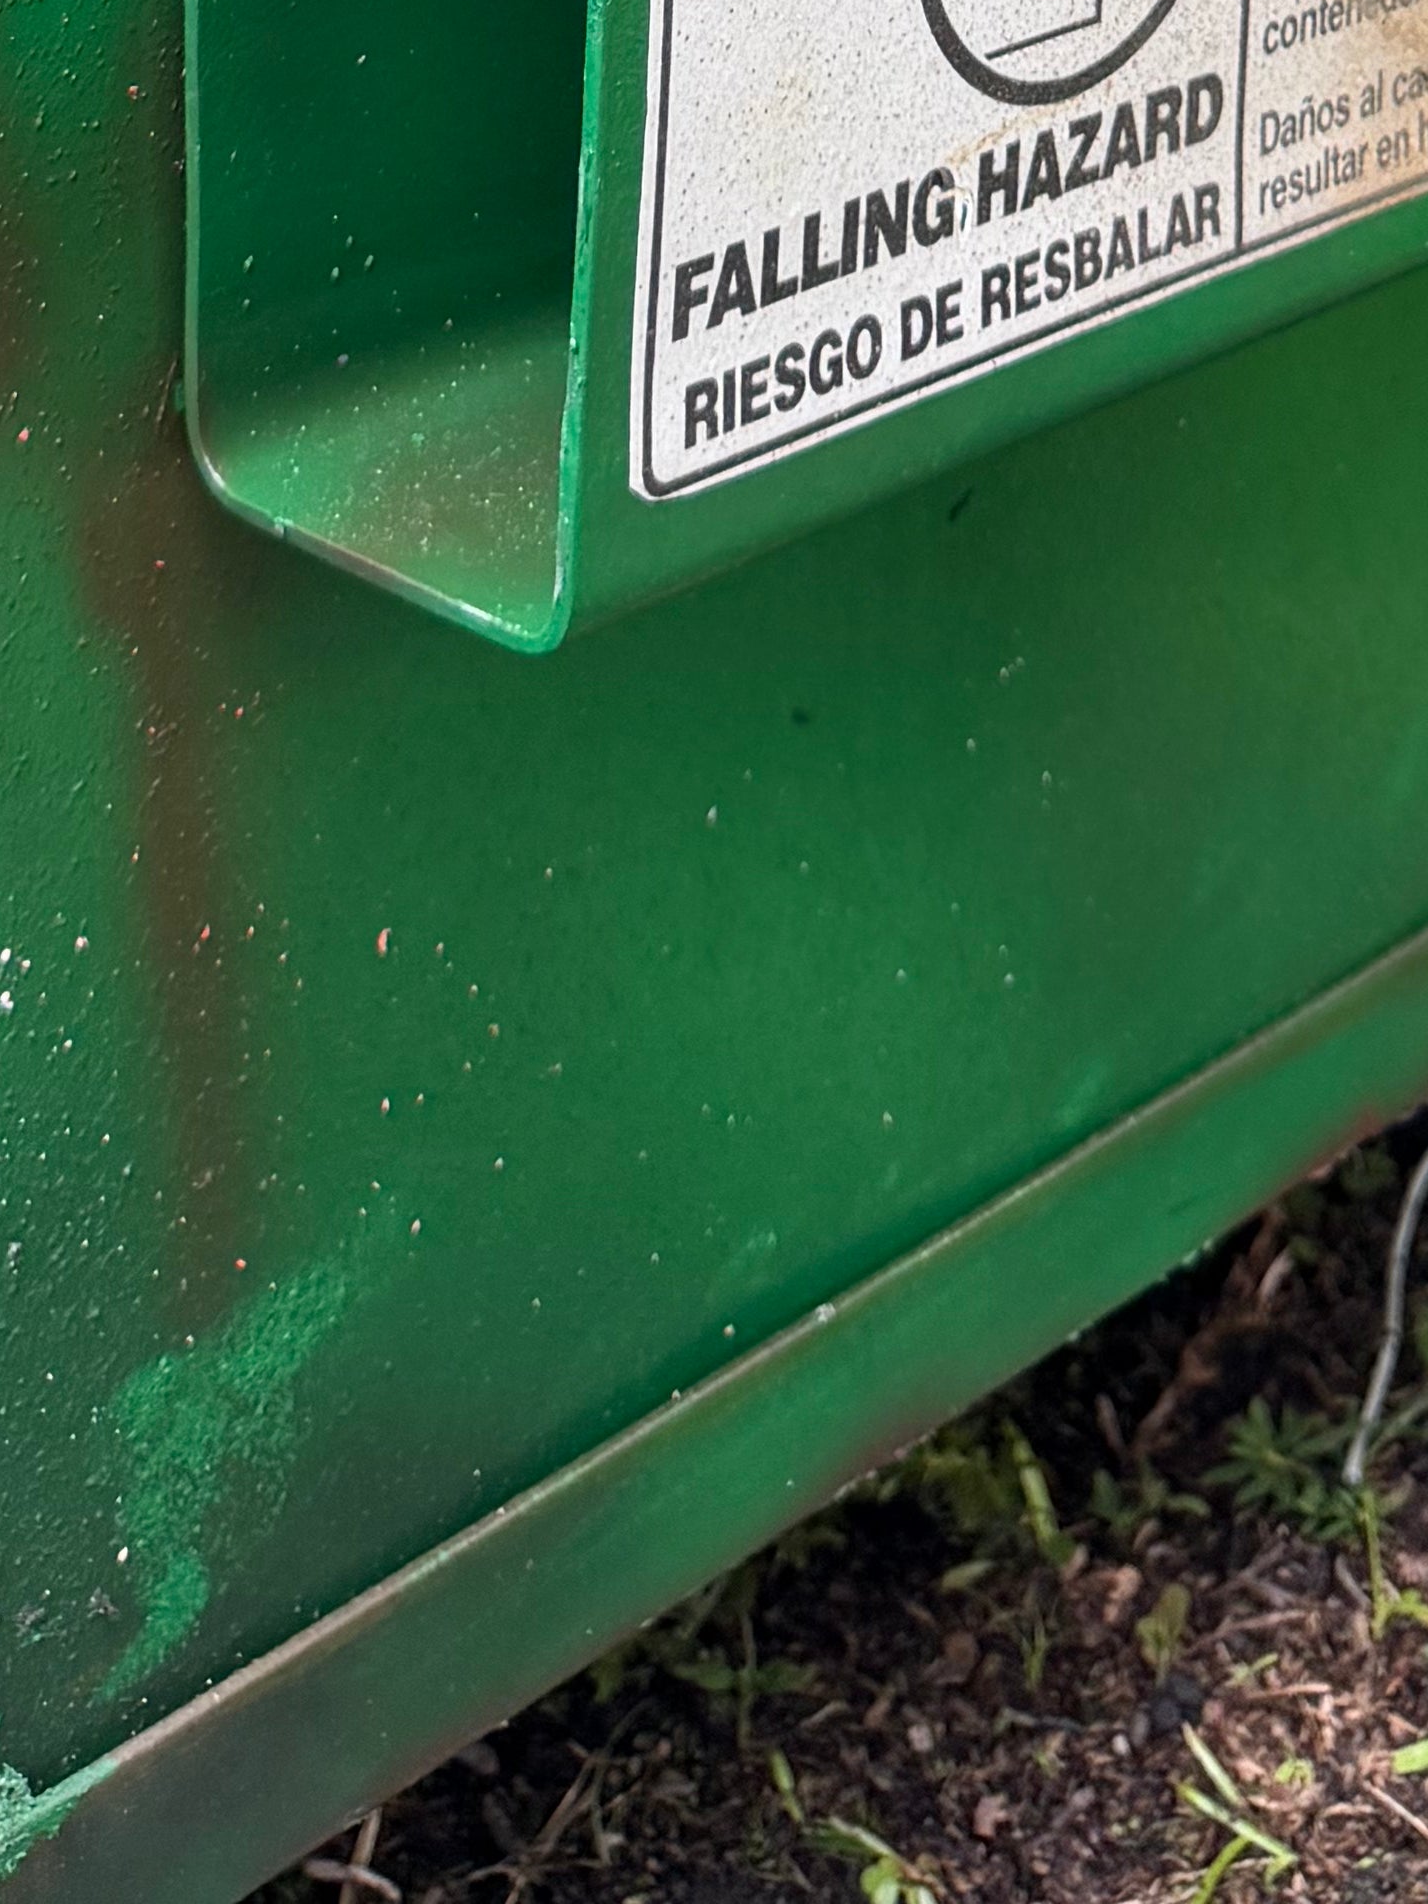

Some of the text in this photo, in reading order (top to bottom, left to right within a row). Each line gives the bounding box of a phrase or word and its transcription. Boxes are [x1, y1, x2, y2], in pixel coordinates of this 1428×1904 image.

[1258, 134, 1371, 216] resultar
[1377, 122, 1410, 162] en
[1260, 94, 1350, 156] Daños
[1360, 68, 1384, 114] al
[672, 72, 1224, 343] FALLING HAZARD
[684, 182, 1222, 450] RIESGO DE RESBALAR
